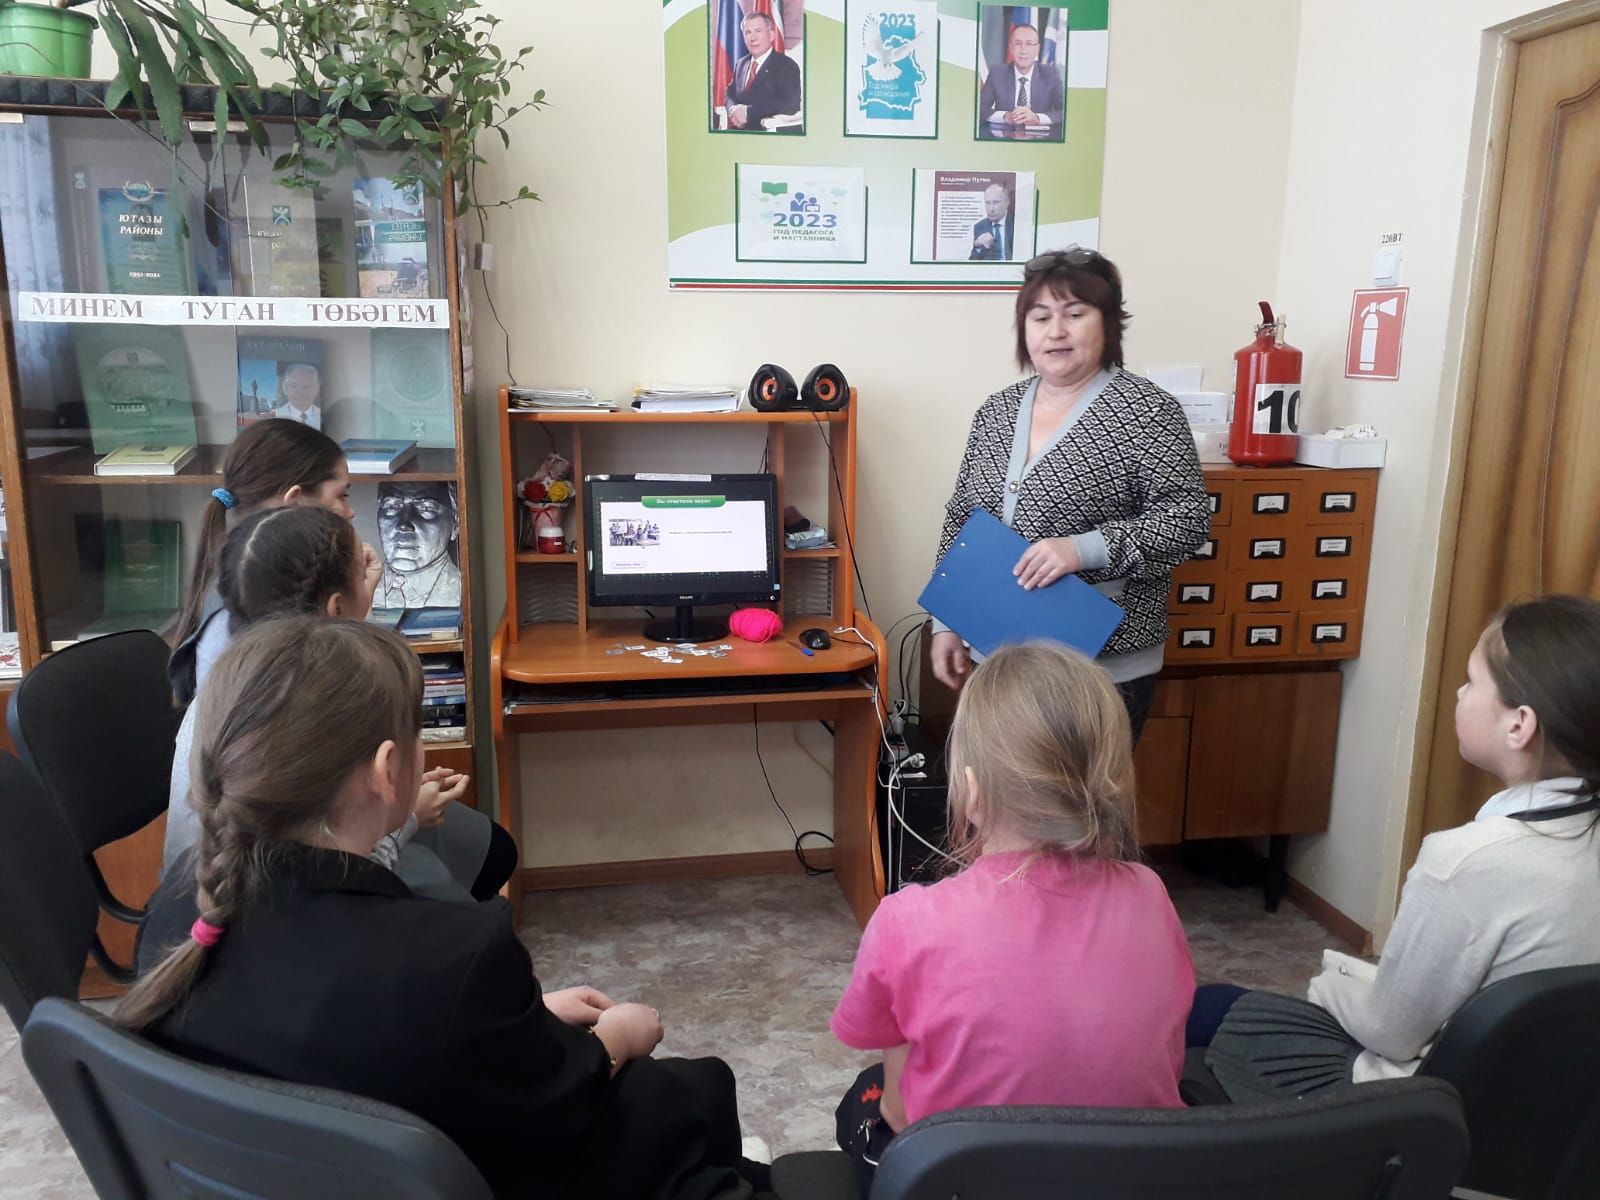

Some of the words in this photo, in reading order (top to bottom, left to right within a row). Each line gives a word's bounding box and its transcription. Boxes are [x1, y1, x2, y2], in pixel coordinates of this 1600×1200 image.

[879, 13, 916, 28] 2023
[972, 176, 991, 184] Путин
[119, 214, 163, 224] ЮТАЗЫ
[773, 213, 837, 228] 2023
[120, 225, 163, 235] РАЙОНЫ
[32, 296, 144, 318] МИНЕМ
[182, 301, 275, 321] ТУГАН
[307, 303, 436, 323] ТӨБӘГЕМ
